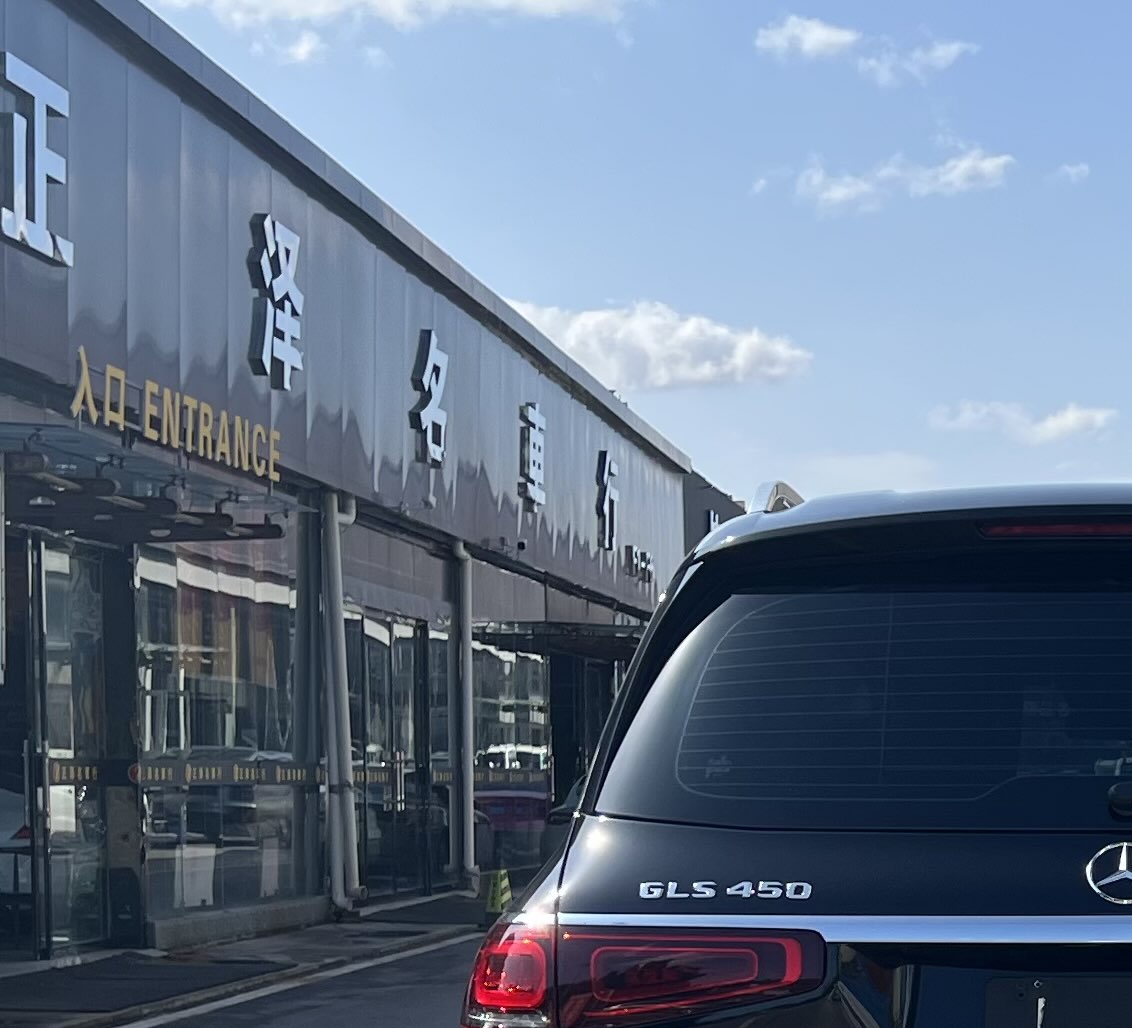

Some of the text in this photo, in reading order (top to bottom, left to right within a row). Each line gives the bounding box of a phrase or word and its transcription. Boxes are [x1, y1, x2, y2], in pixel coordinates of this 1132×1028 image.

[70, 345, 126, 431] 入口
[143, 379, 281, 482] ENTRANCE
[639, 881, 812, 899] GLS 450
